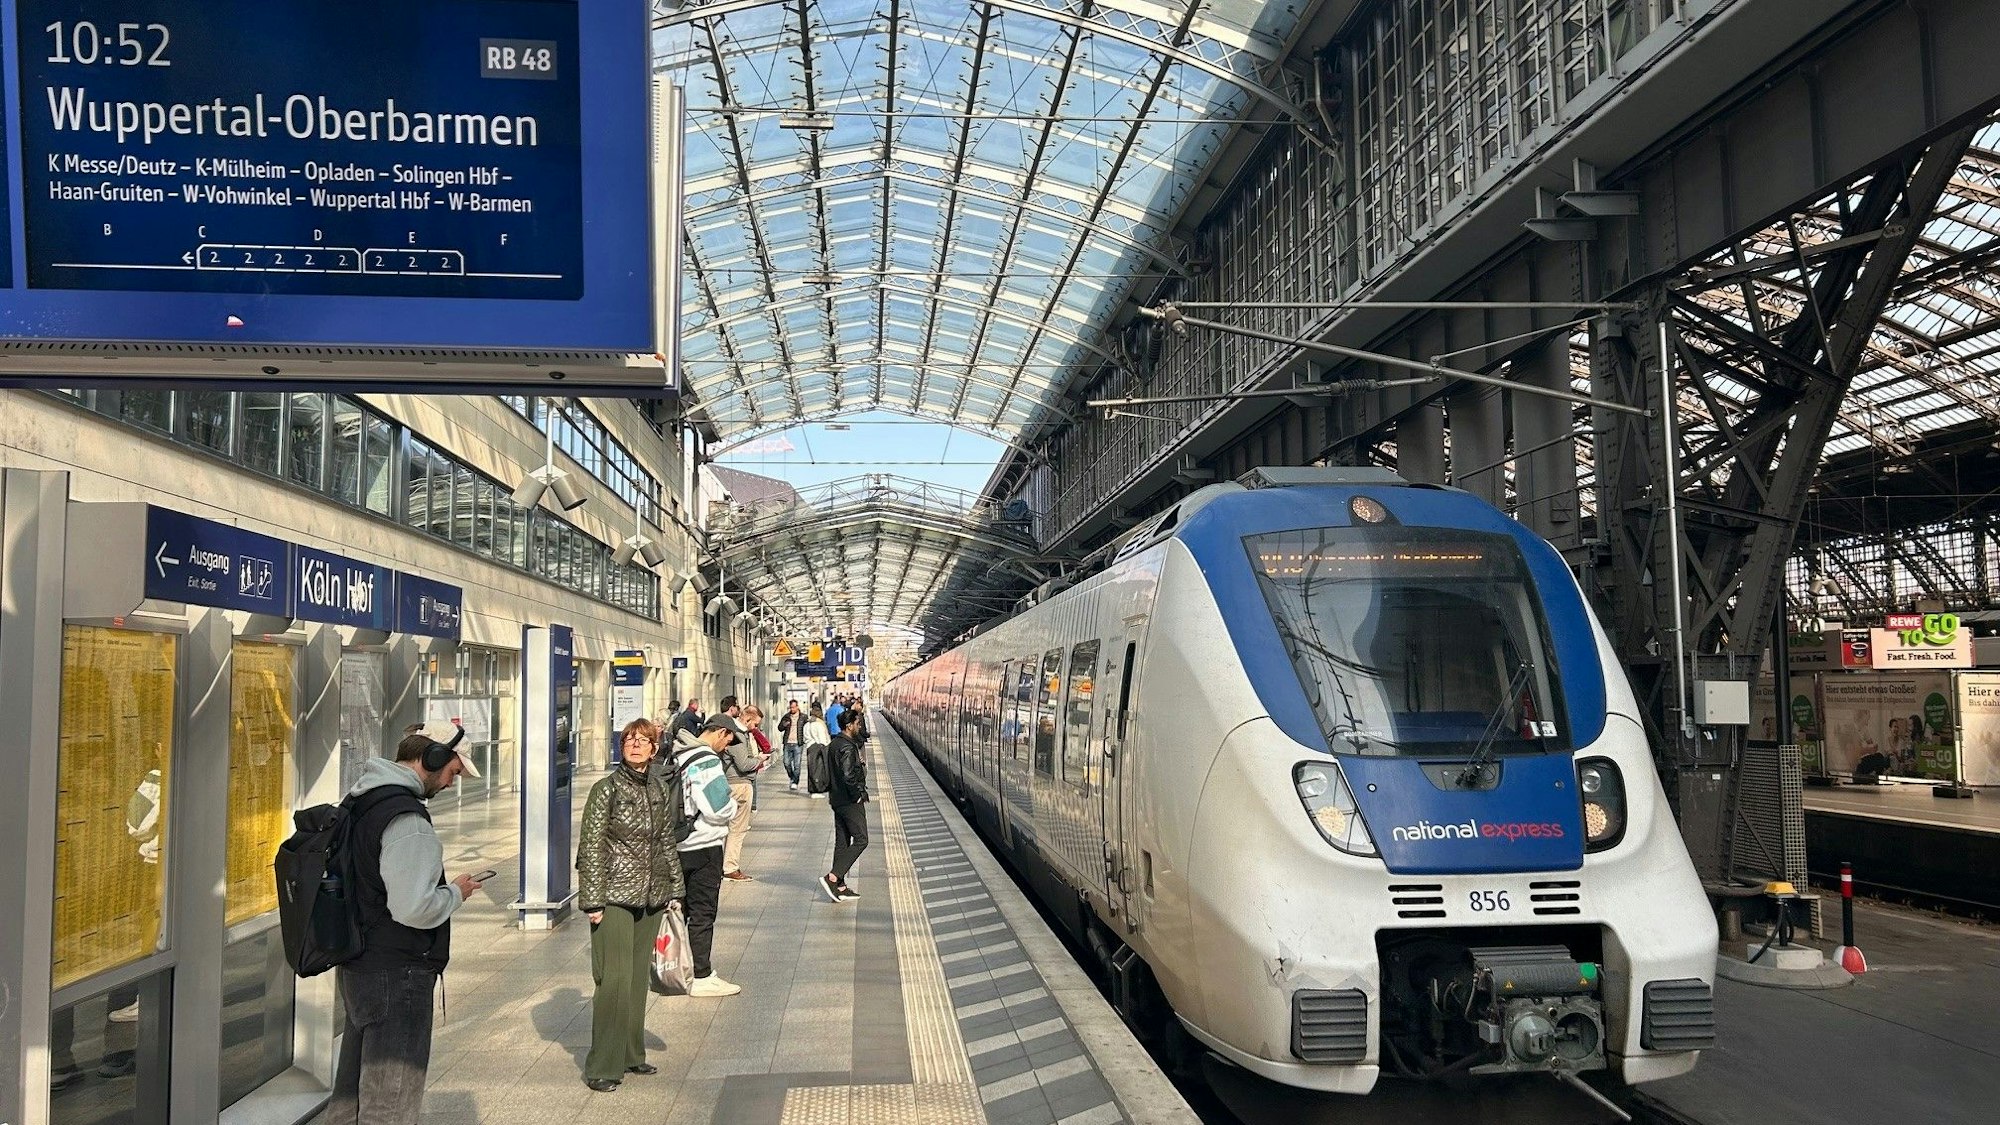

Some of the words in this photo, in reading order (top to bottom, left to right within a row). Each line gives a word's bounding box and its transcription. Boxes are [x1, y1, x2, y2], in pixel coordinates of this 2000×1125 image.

[45, 21, 171, 67] 10:52
[487, 46, 516, 70] RB
[521, 48, 551, 72] 48
[46, 86, 538, 146] Wuppertal-Oberbarmen
[48, 154, 60, 172] K
[64, 154, 177, 176] Messe/Deutz
[195, 157, 286, 179] K-Mülheim
[304, 160, 375, 185] Opladen
[393, 163, 465, 188] Solingen
[469, 166, 499, 185] Hbf
[49, 180, 164, 202] Haan-Gruiten
[183, 183, 293, 206] W-Vohwinkel
[309, 187, 397, 212] Wuppertal
[400, 191, 431, 210] Hbf
[448, 191, 532, 213] W-Barmen
[103, 223, 112, 236] B
[197, 225, 206, 238] C
[313, 229, 323, 241] D
[408, 231, 416, 244] E
[500, 233, 508, 246] F
[188, 544, 230, 575] Ausgang
[301, 556, 341, 608] Köln
[1889, 616, 1921, 627] REWE
[1924, 613, 1957, 634] GO
[1897, 629, 1924, 646] TO
[835, 647, 842, 663] 1
[850, 647, 863, 663] D
[1887, 653, 1907, 661] Fast.
[1908, 652, 1933, 661] Fresh.
[1934, 652, 1957, 660] Food.
[1968, 686, 1991, 697] Hier
[1936, 749, 1953, 763] GO
[1392, 818, 1479, 841] national
[1480, 822, 1564, 842] express
[1469, 890, 1511, 912] 856
